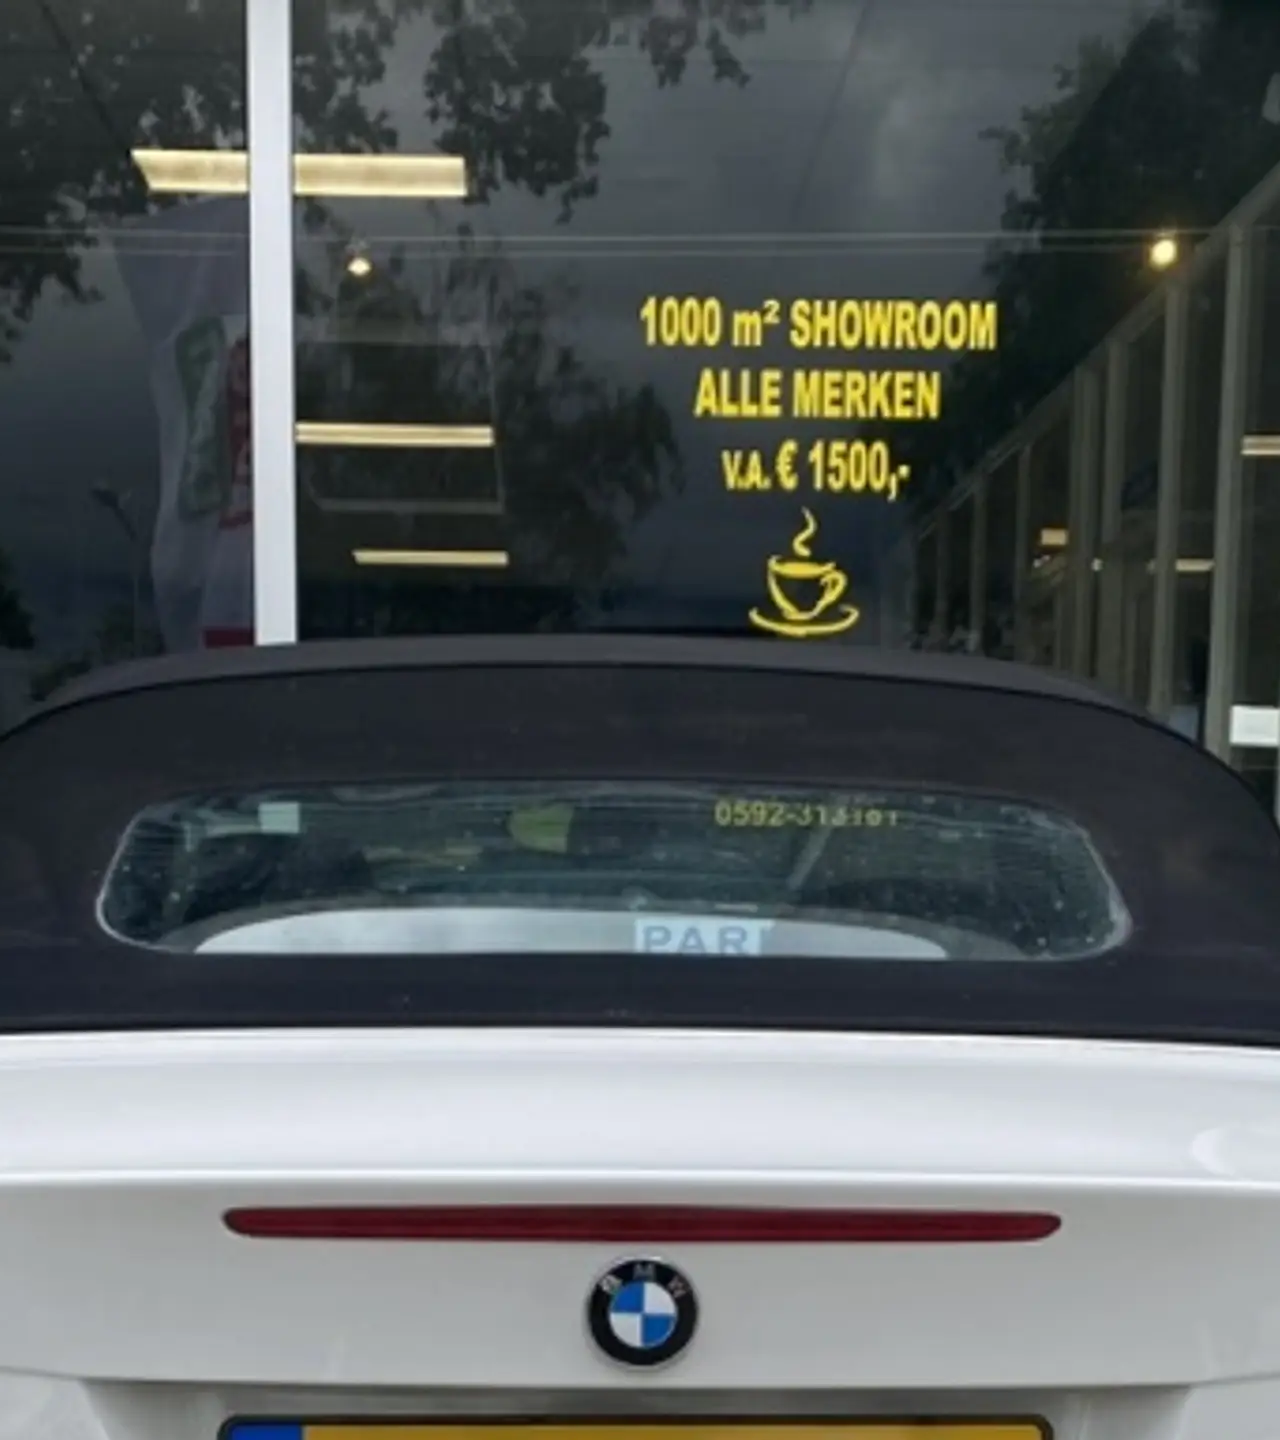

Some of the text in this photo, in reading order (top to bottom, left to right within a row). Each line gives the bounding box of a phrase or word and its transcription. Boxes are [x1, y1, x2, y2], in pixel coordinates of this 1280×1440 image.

[641, 297, 997, 350] 1000 m² SHOWROOM
[694, 368, 940, 419] ALLE MERKEN
[775, 440, 798, 490] €
[808, 441, 911, 501] 1500,-
